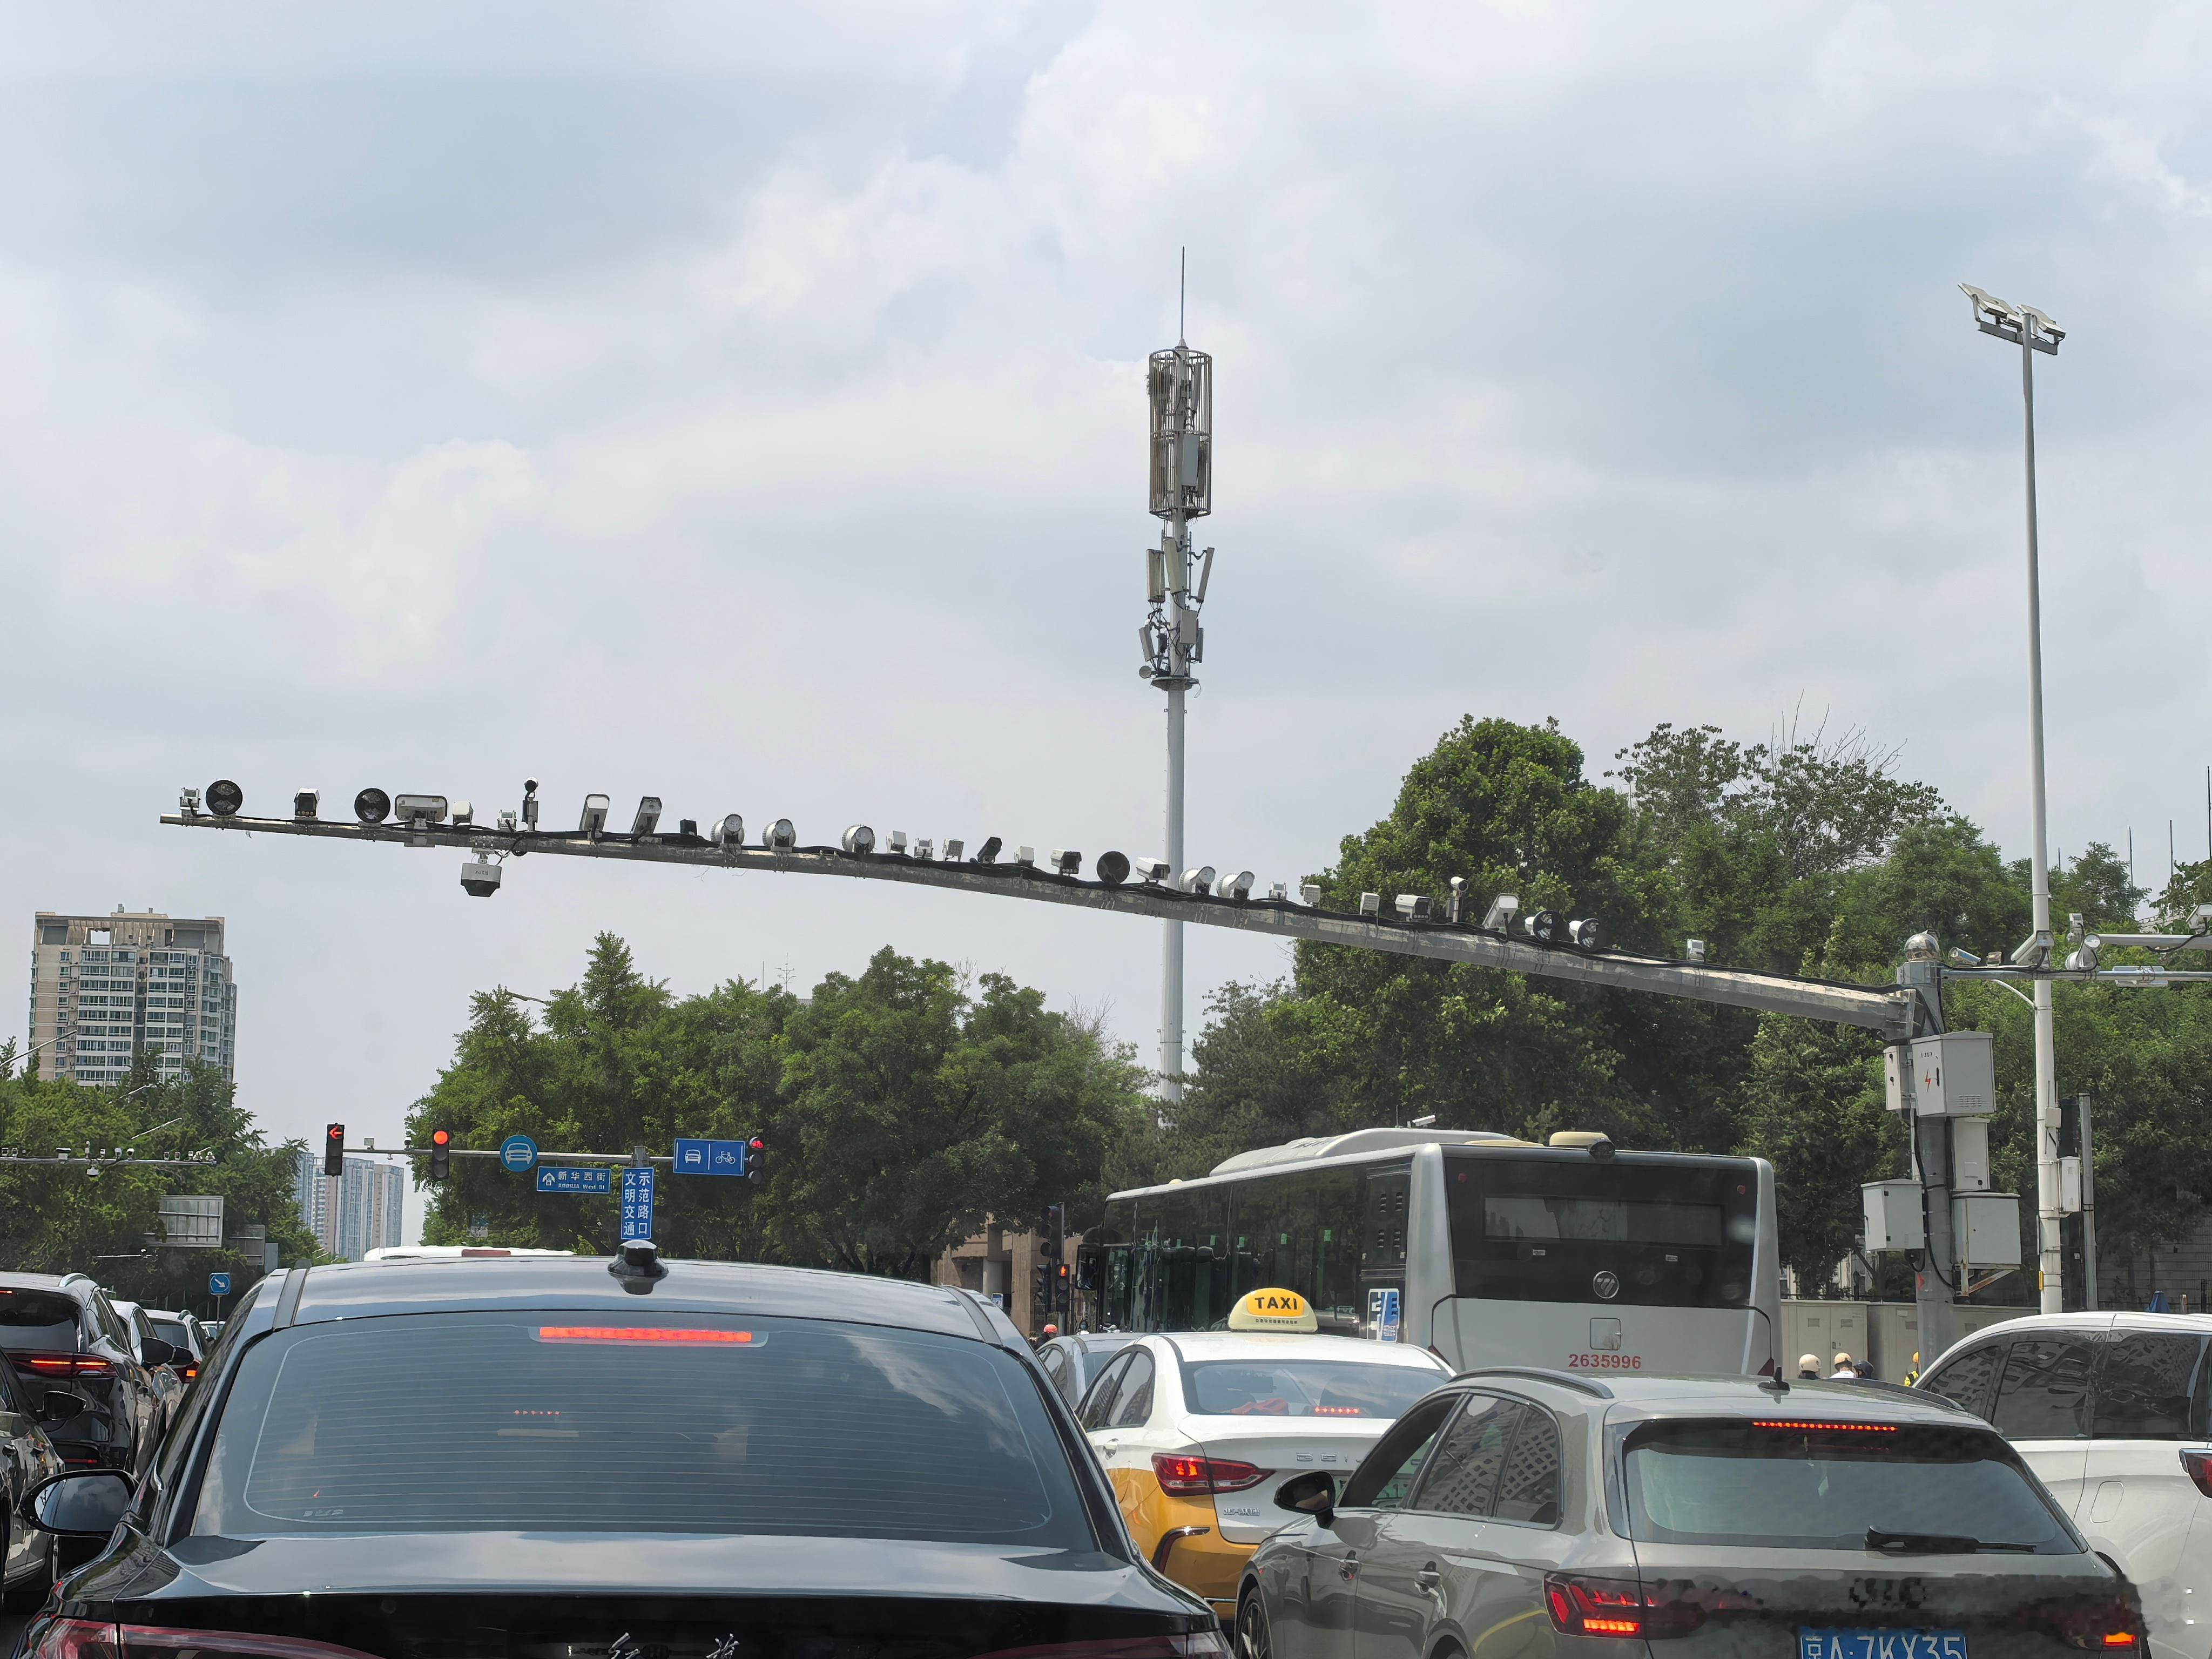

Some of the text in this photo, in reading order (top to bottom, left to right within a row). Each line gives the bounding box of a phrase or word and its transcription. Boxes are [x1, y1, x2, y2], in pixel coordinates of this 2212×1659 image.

[558, 1171, 606, 1182] 新华西街
[624, 1171, 636, 1236] 文明交通
[637, 1172, 650, 1235] 示范路口
[1255, 1297, 1298, 1310] TAXI
[1568, 1354, 1641, 1370] 2635996
